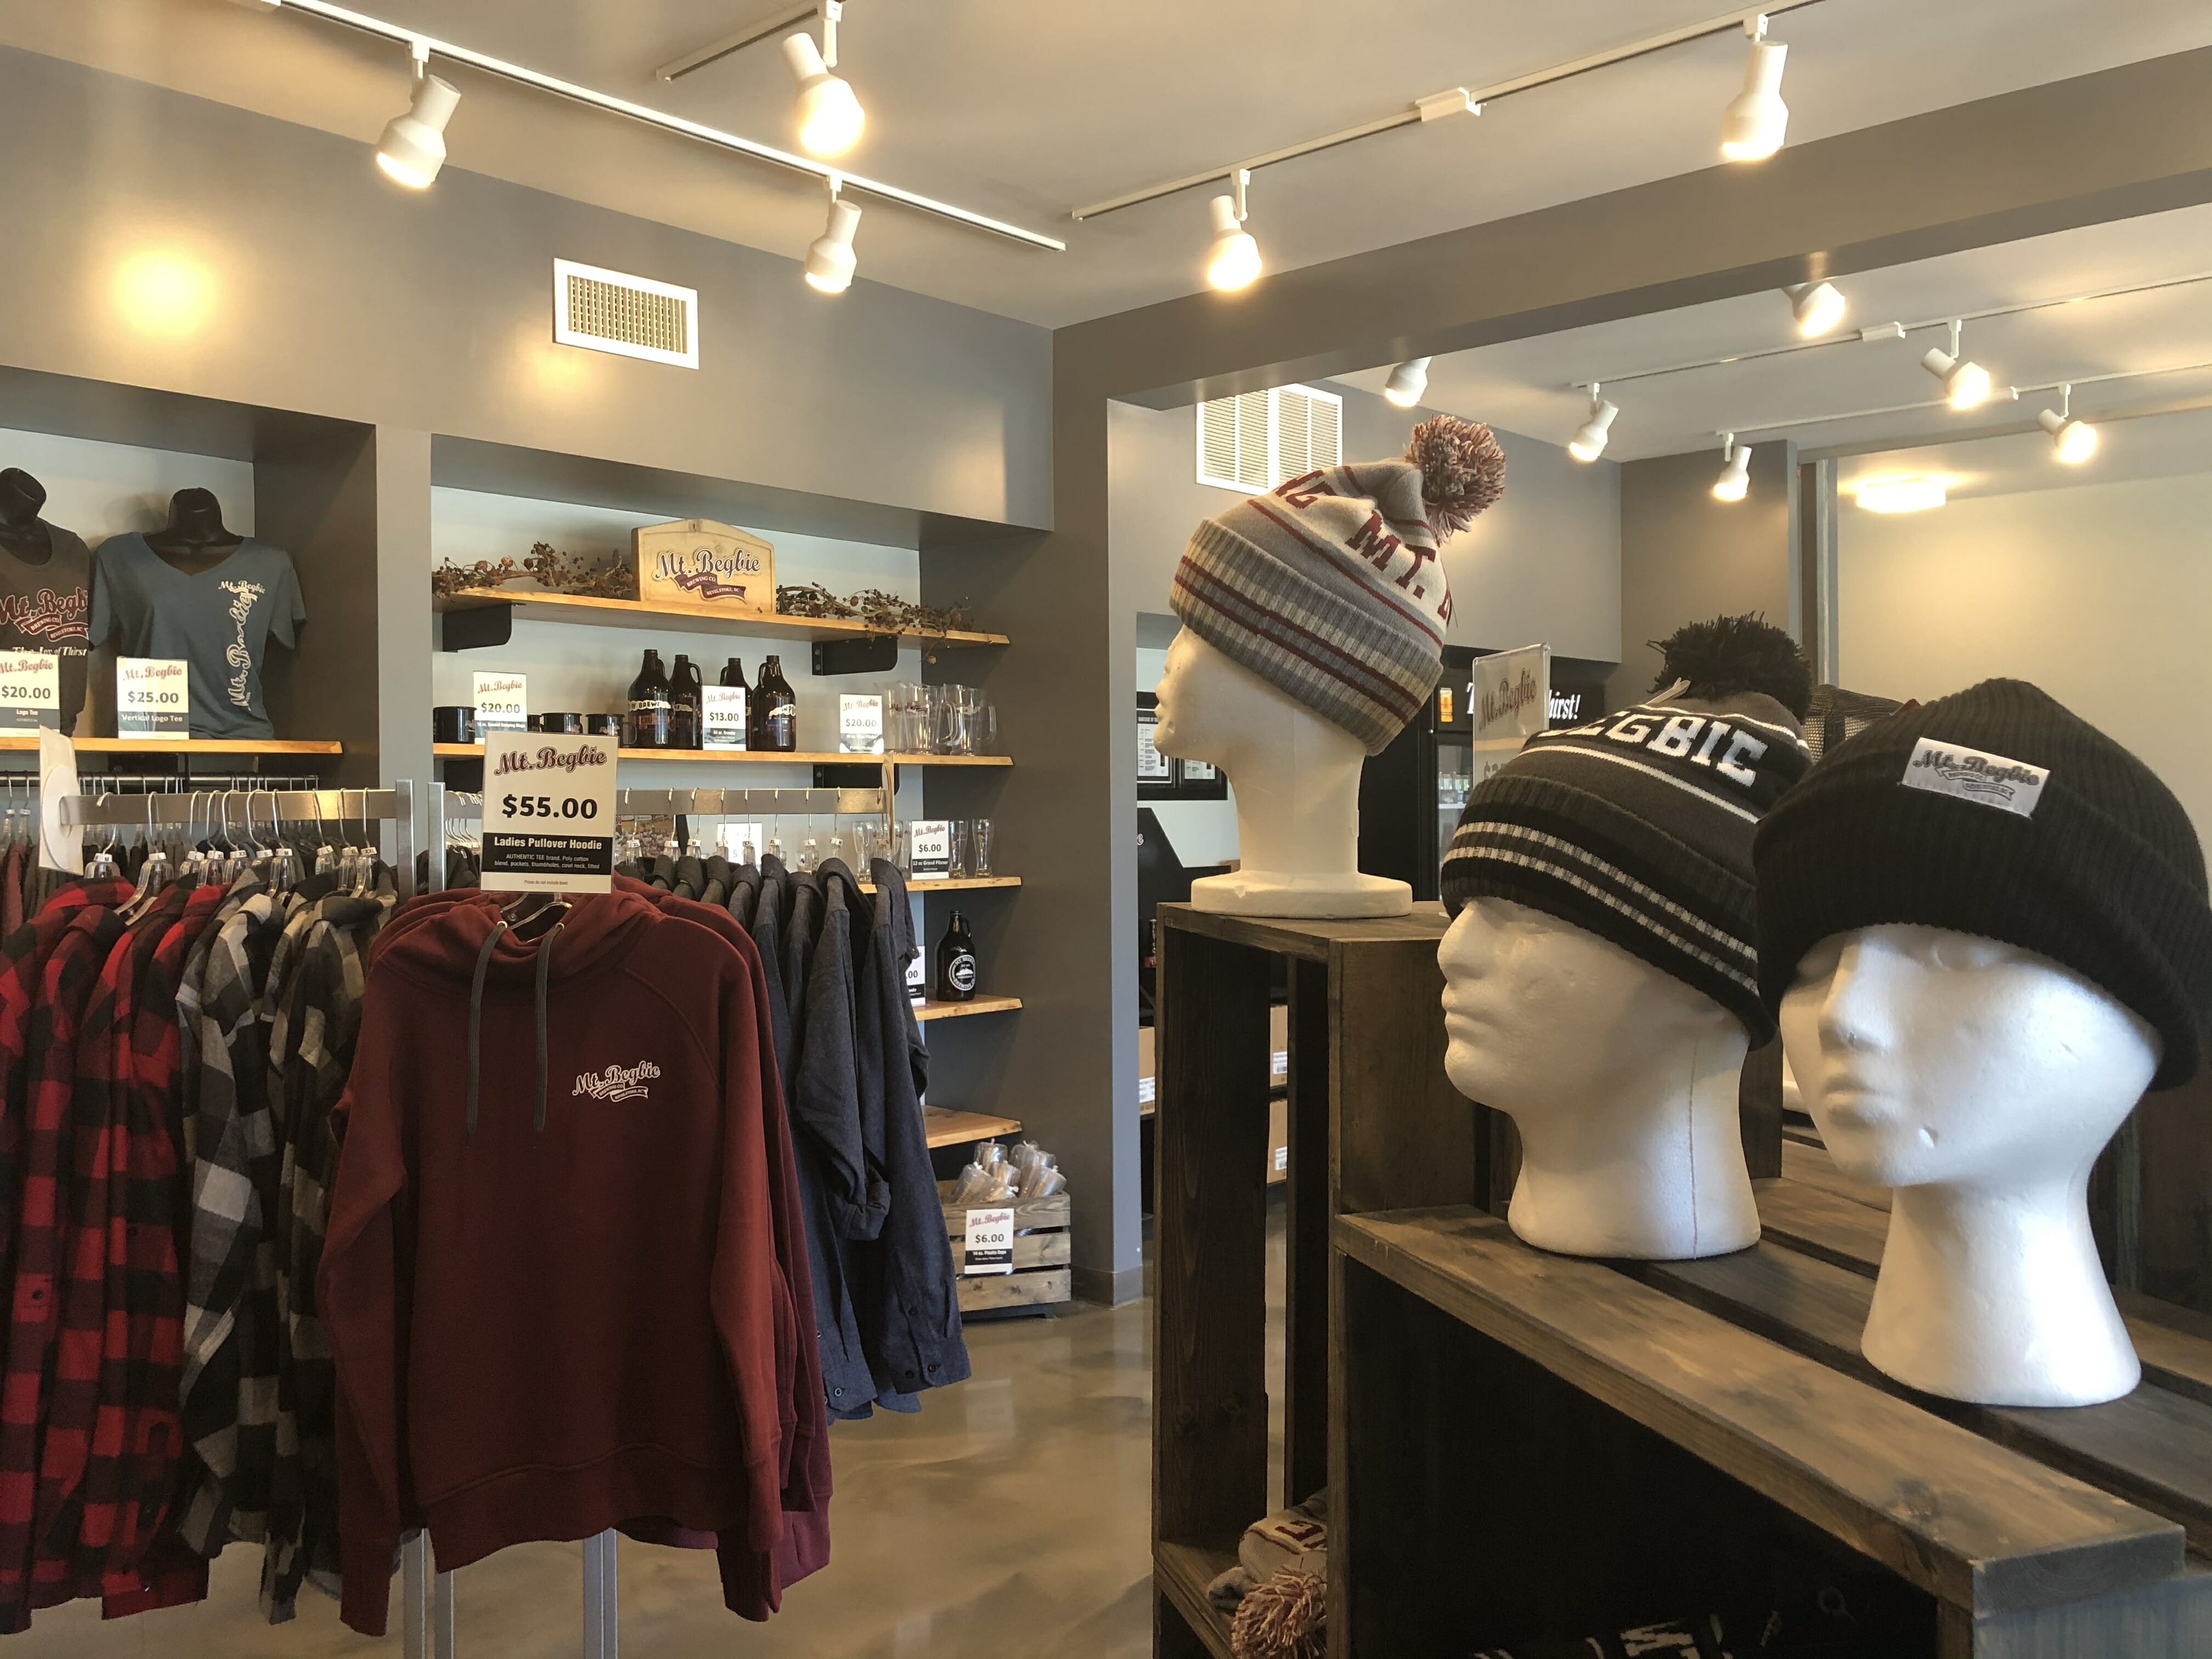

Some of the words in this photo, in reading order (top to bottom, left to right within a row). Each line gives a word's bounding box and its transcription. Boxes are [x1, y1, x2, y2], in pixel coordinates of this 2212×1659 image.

[1345, 510, 1436, 599] MT.
[653, 551, 692, 579] Mt.
[695, 548, 760, 579] Begbie
[238, 580, 266, 594] Begbie
[686, 575, 708, 587] BREWING
[30, 617, 52, 631] BREWING
[63, 647, 87, 656] Thirst
[18, 658, 53, 674] Begbie
[123, 669, 143, 681] Mt.
[145, 664, 183, 680] Begbie
[2, 685, 51, 699] $20.00
[477, 683, 493, 694] Mt.
[494, 680, 522, 692] Begbie
[1498, 668, 1536, 719] Begbie
[128, 690, 179, 703] $25.00
[719, 691, 741, 702] Begbie
[481, 702, 521, 714] $20.00
[1549, 690, 1581, 720] hirst!
[709, 712, 739, 722] $13.00
[845, 718, 877, 727] $20.00
[1537, 711, 1768, 787] EGBIE
[494, 751, 535, 776] Mt.
[536, 744, 607, 773] Begbie
[501, 794, 597, 819] $55.00
[924, 824, 945, 835] Begbie
[494, 836, 526, 847] Ladies
[528, 838, 567, 849] Pullover
[569, 839, 602, 850] Hoodie
[918, 844, 941, 853] $6.00
[572, 1072, 603, 1096] Mt.
[605, 1060, 661, 1086] Begbie
[984, 1212, 1010, 1224] Begbie
[975, 1233, 1005, 1244] $6.00
